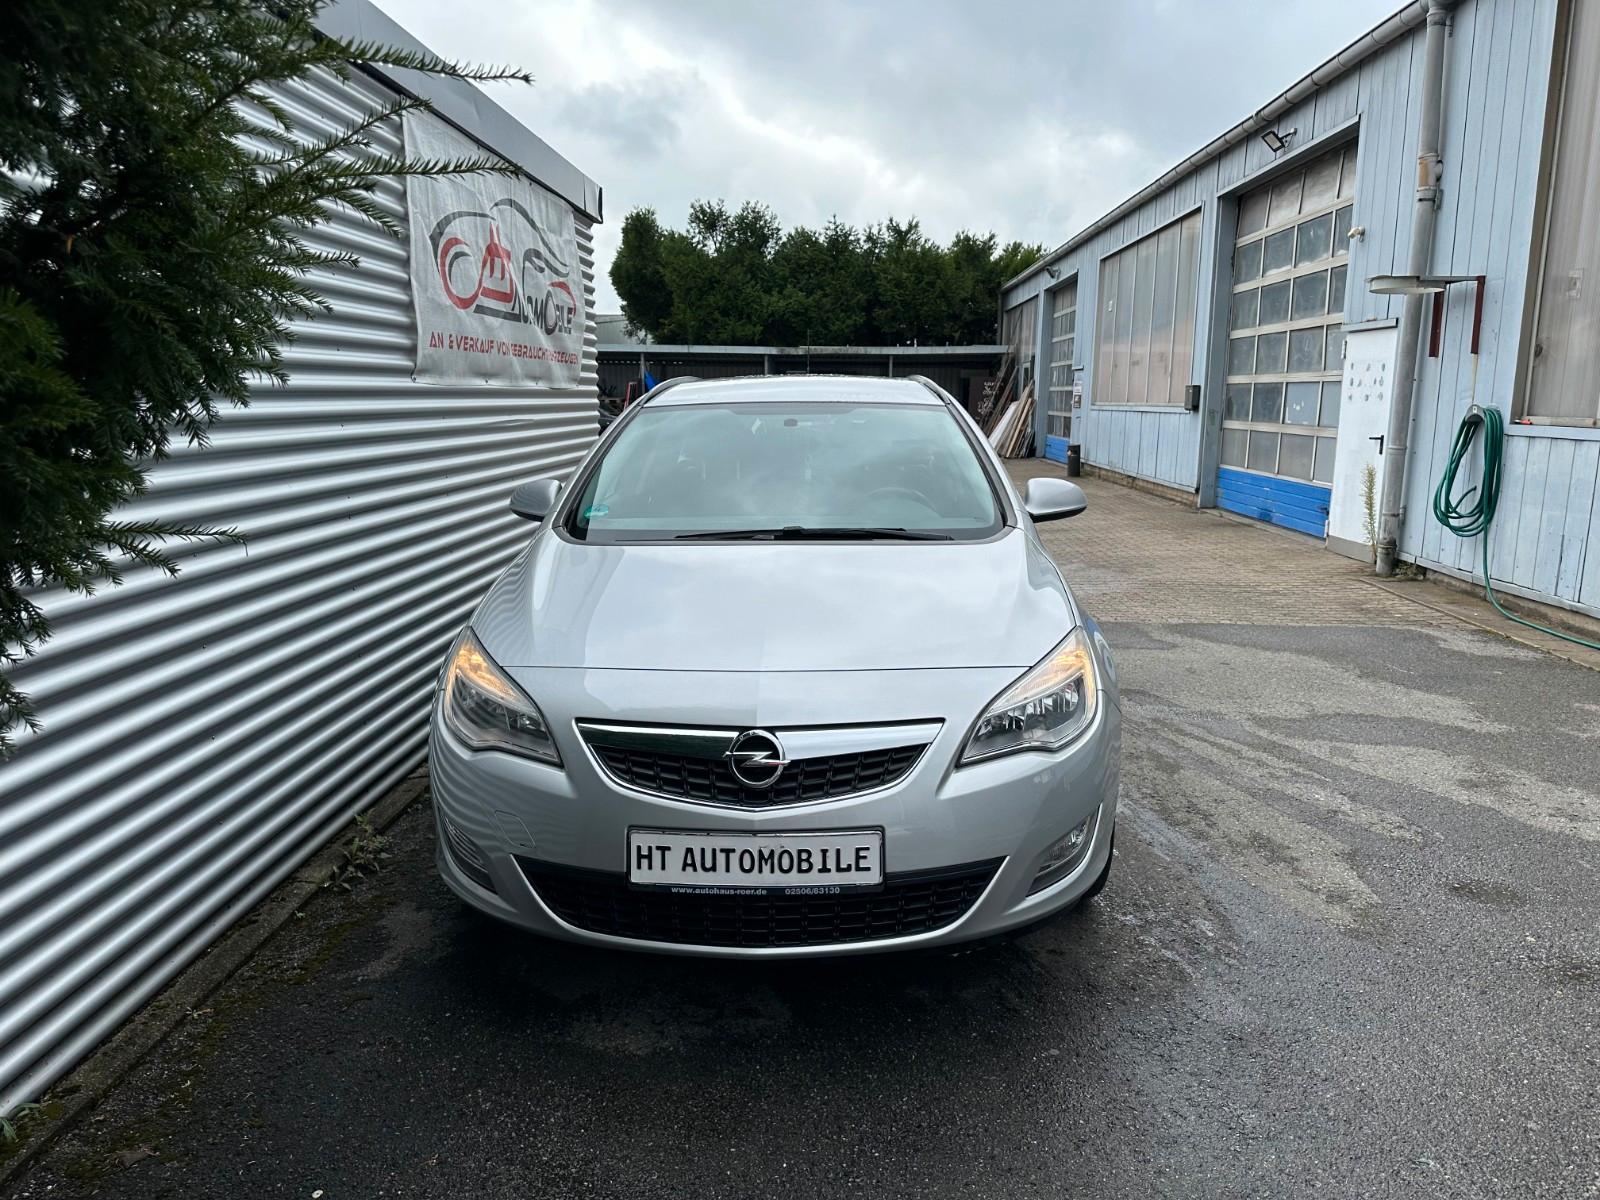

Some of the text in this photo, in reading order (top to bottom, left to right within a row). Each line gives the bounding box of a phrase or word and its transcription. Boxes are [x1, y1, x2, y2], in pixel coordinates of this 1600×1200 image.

[429, 331, 444, 350] AN
[455, 334, 494, 354] VERKAUF
[635, 845, 872, 875] HT AUTOMOBILE
[671, 886, 768, 896] www.autohaus-roer.de
